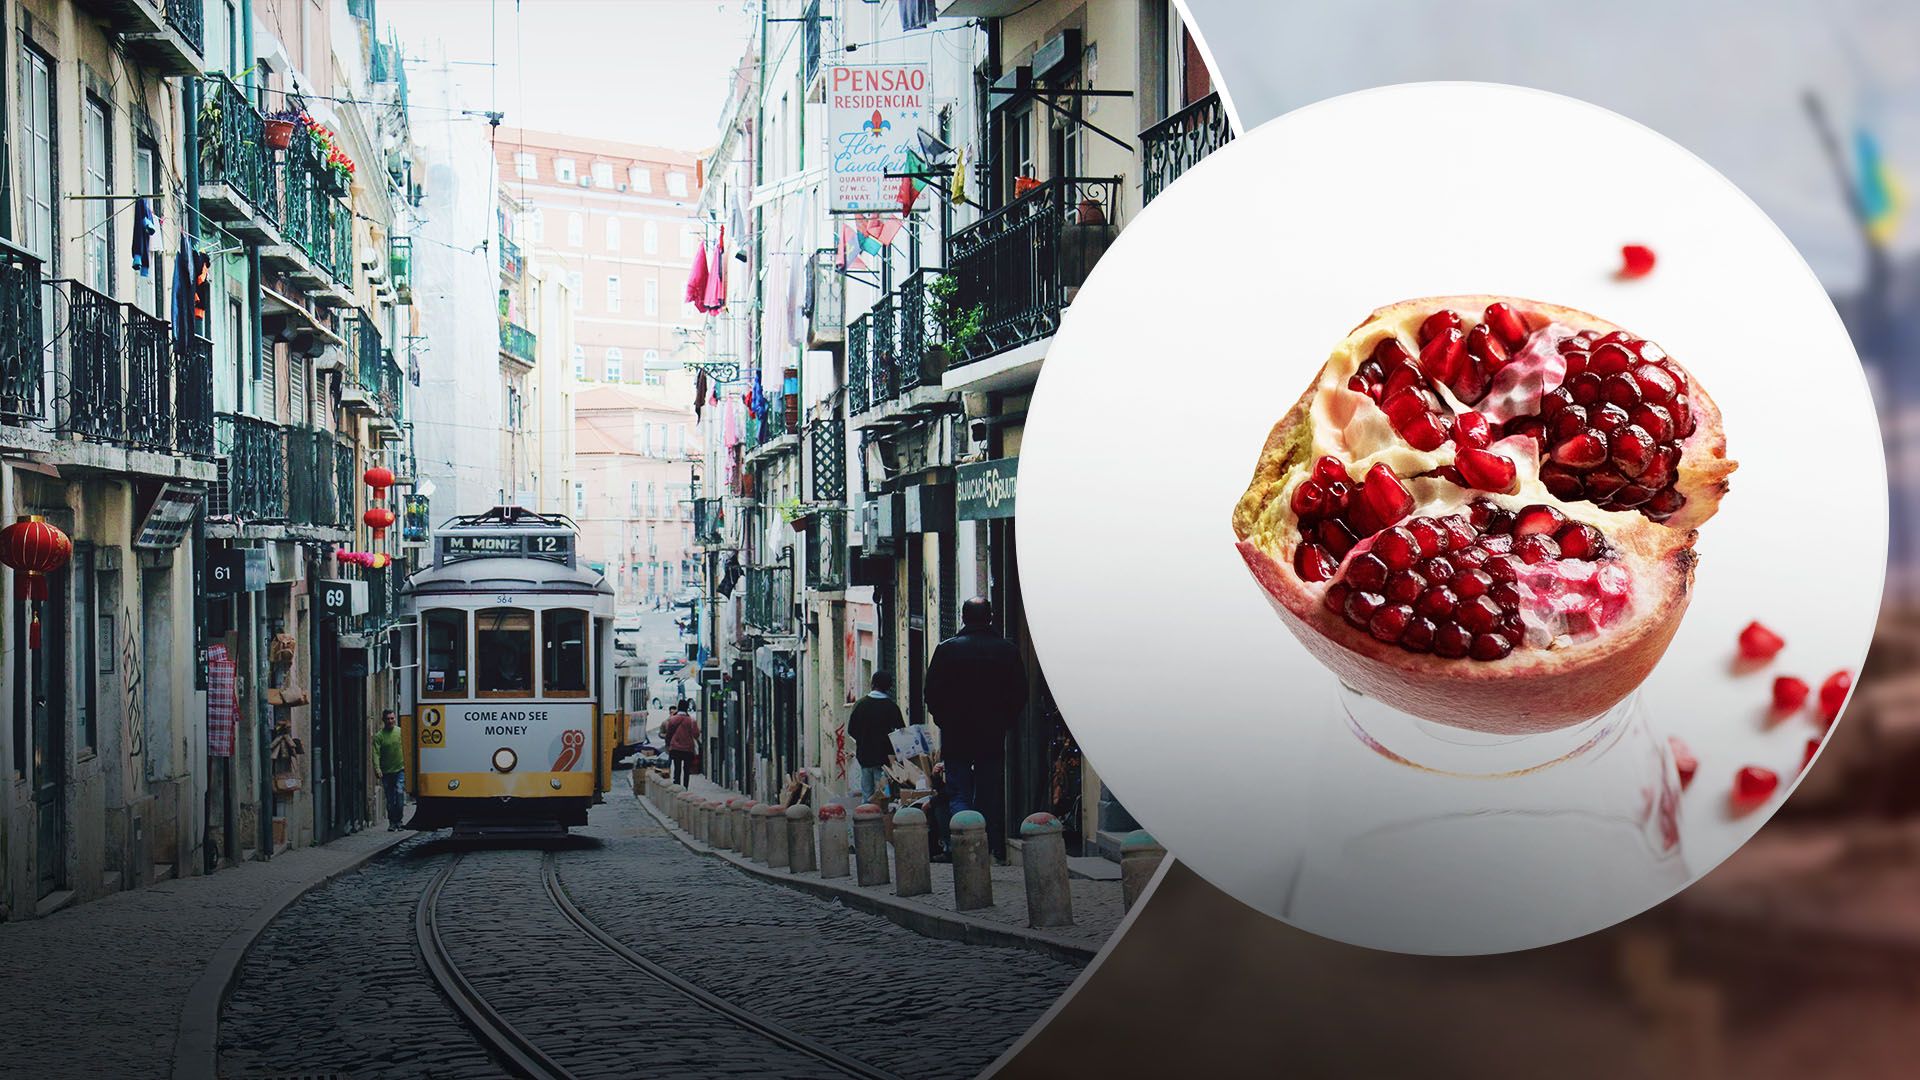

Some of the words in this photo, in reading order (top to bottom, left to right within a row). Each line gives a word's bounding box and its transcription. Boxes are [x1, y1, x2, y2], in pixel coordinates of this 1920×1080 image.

[835, 95, 923, 109] RESIDENCIAL
[838, 132, 887, 156] Flor
[986, 468, 1001, 508] 56
[450, 538, 465, 548] M.
[472, 539, 520, 550] MONIZ
[536, 537, 557, 552] 12
[214, 566, 231, 580] 61
[325, 589, 345, 607] 69
[496, 595, 513, 604] 564
[464, 711, 498, 721] COME
[500, 711, 526, 721] AND
[528, 711, 548, 721] SEE
[484, 726, 528, 736] MONEY
